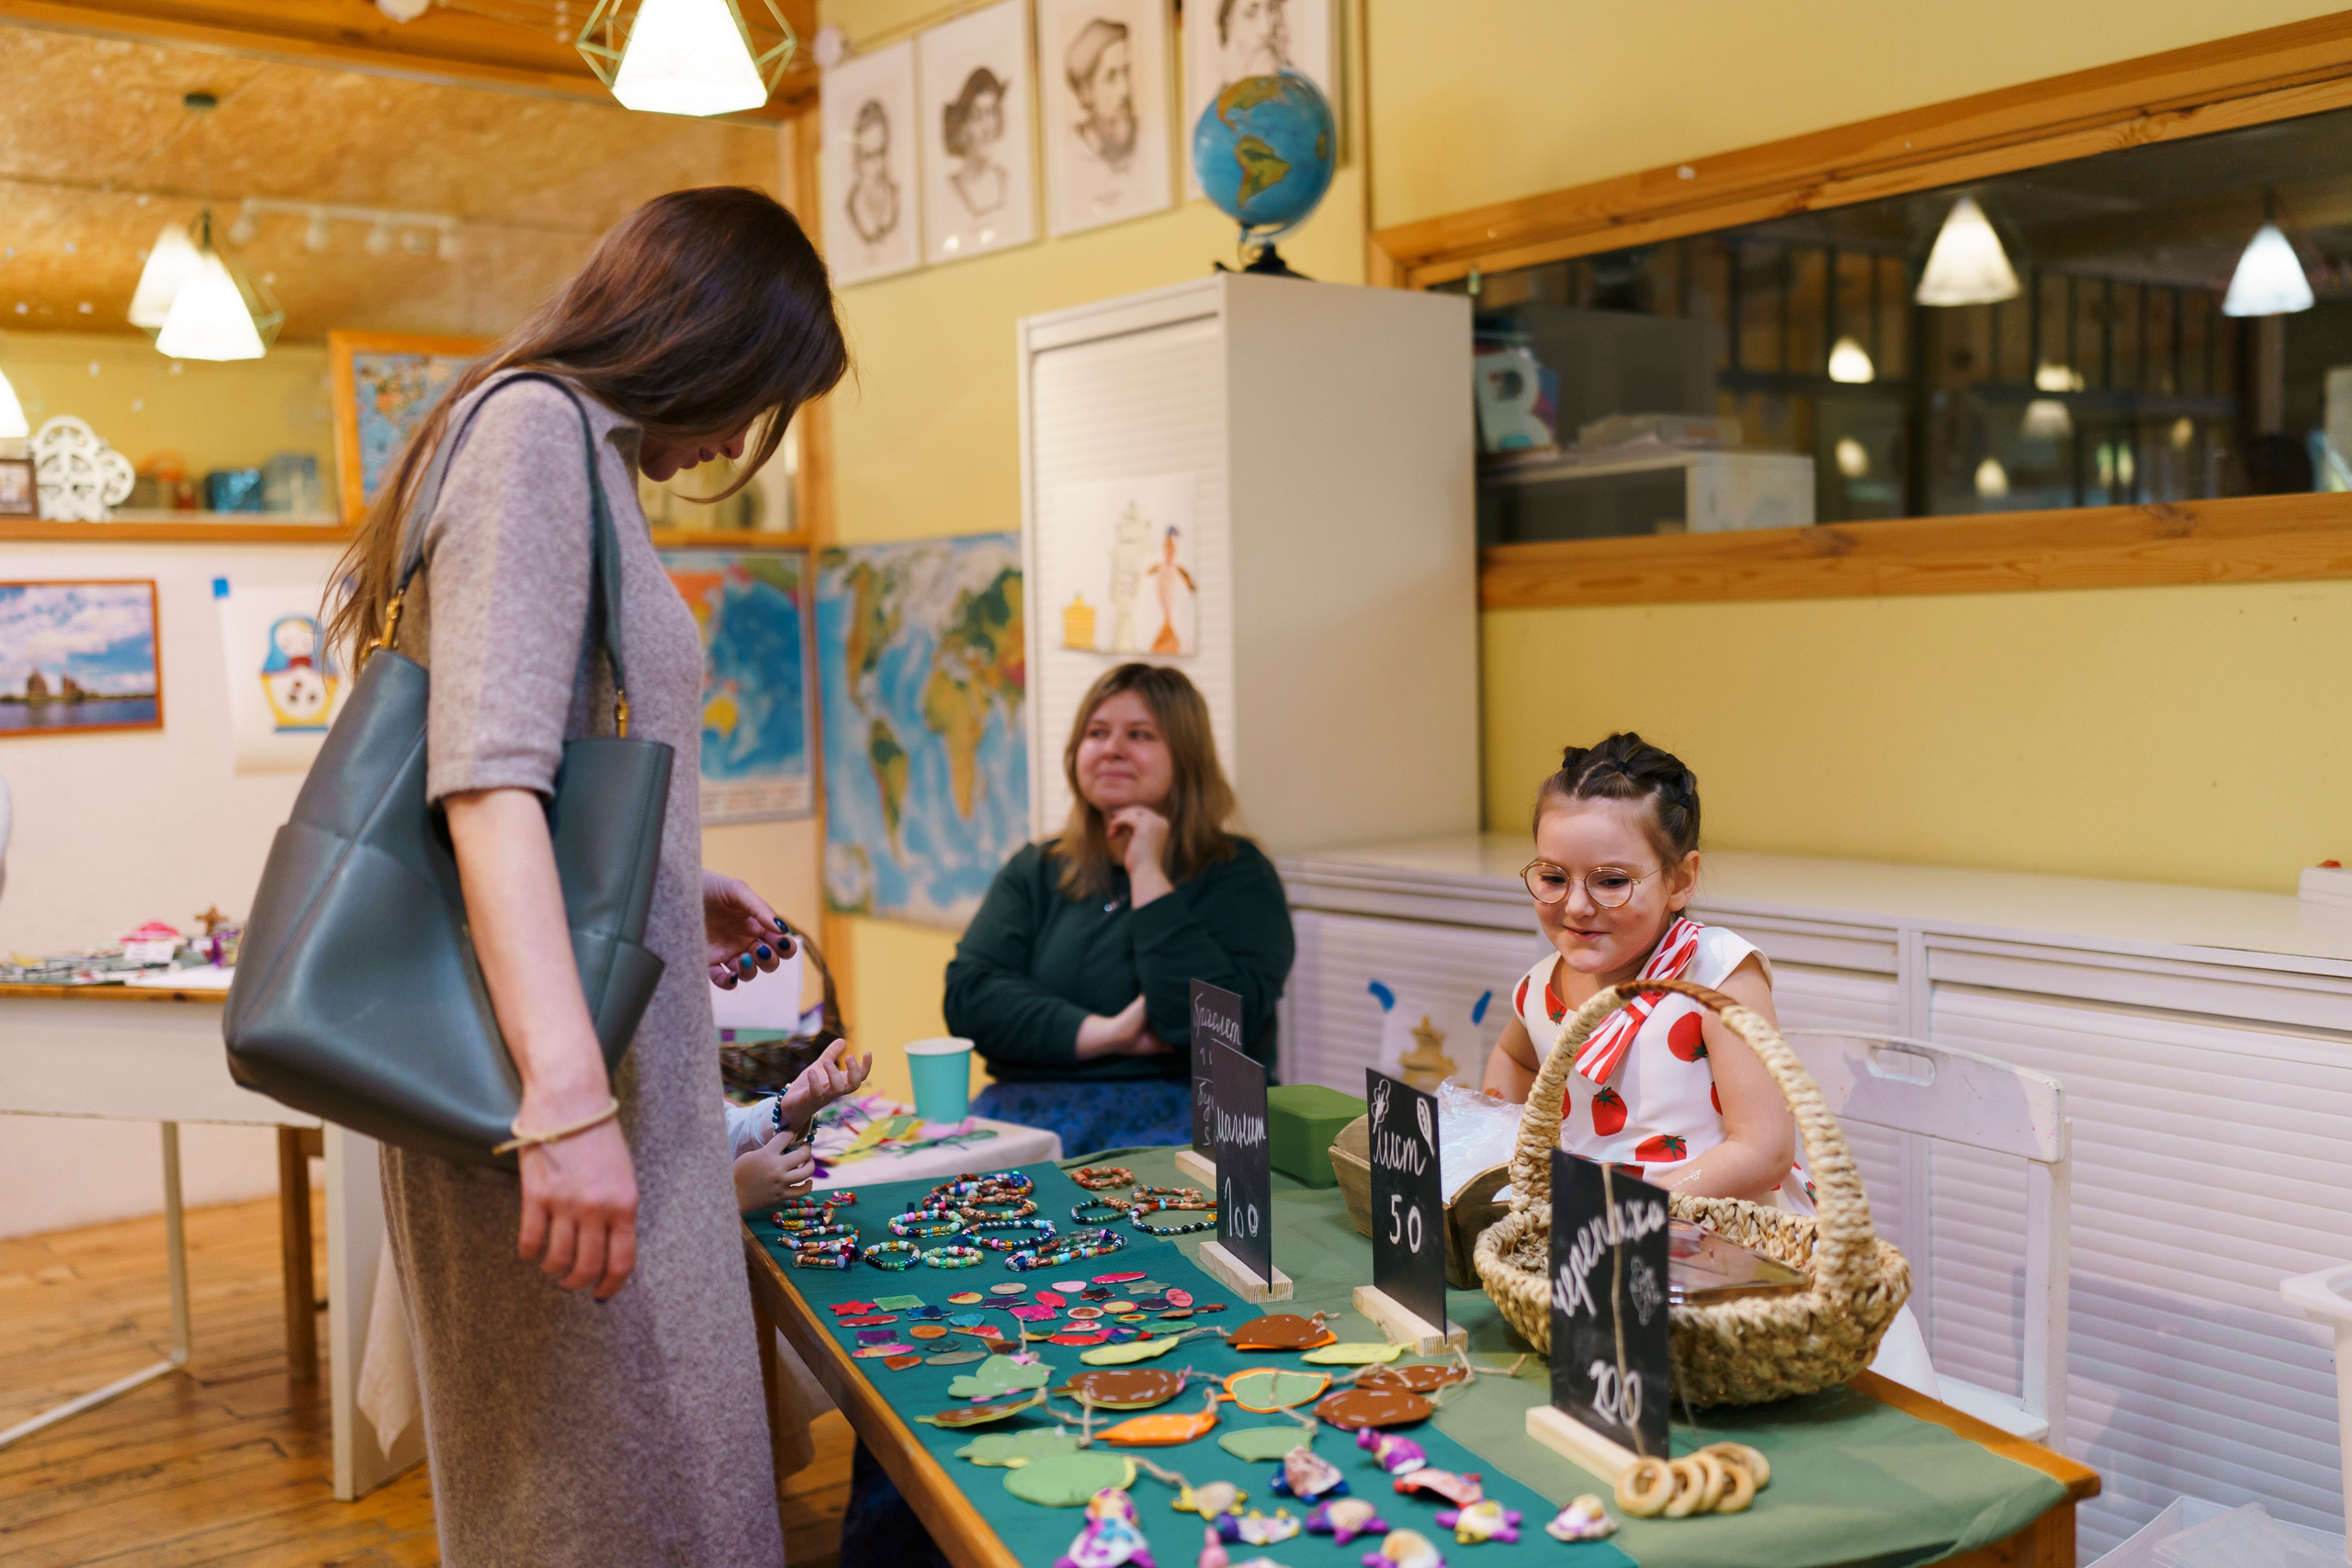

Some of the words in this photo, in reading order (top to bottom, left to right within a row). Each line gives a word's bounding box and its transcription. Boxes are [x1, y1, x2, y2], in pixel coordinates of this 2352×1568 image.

[1199, 1047, 1213, 1066] 1
[1198, 1081, 1215, 1122] бу
[1216, 1106, 1267, 1148] магнит
[1374, 1126, 1428, 1177] лист
[1225, 1177, 1258, 1238] 100
[1389, 1194, 1422, 1254] 50
[1553, 1198, 1667, 1317] черепаха
[1588, 1359, 1643, 1427] 200
